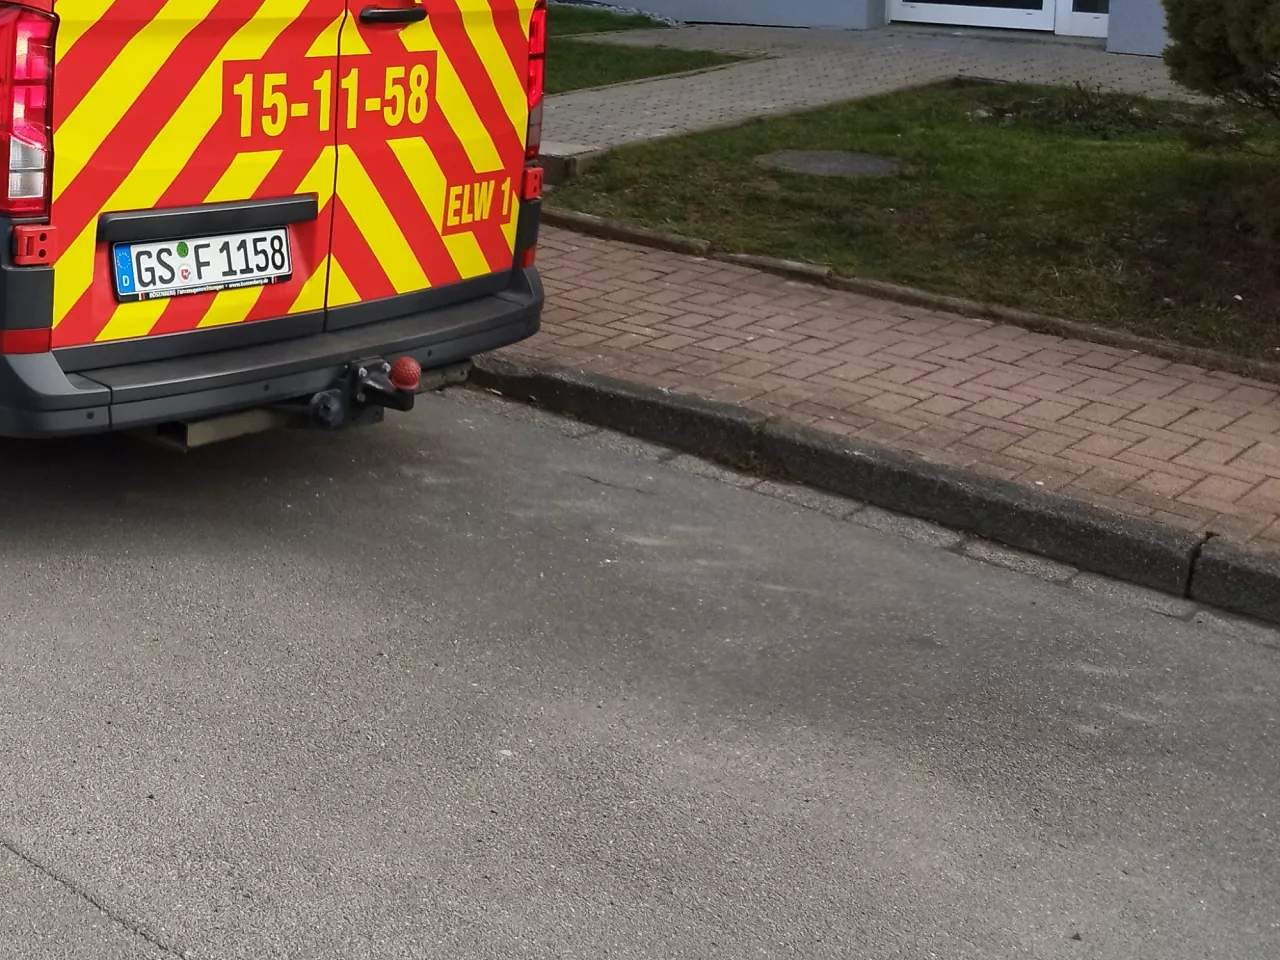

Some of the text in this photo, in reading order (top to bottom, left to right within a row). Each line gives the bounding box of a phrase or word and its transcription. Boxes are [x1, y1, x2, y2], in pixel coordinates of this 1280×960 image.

[233, 64, 429, 137] 15-11-58
[446, 176, 511, 226] ELW 1
[122, 234, 286, 288] D GS F 1158
